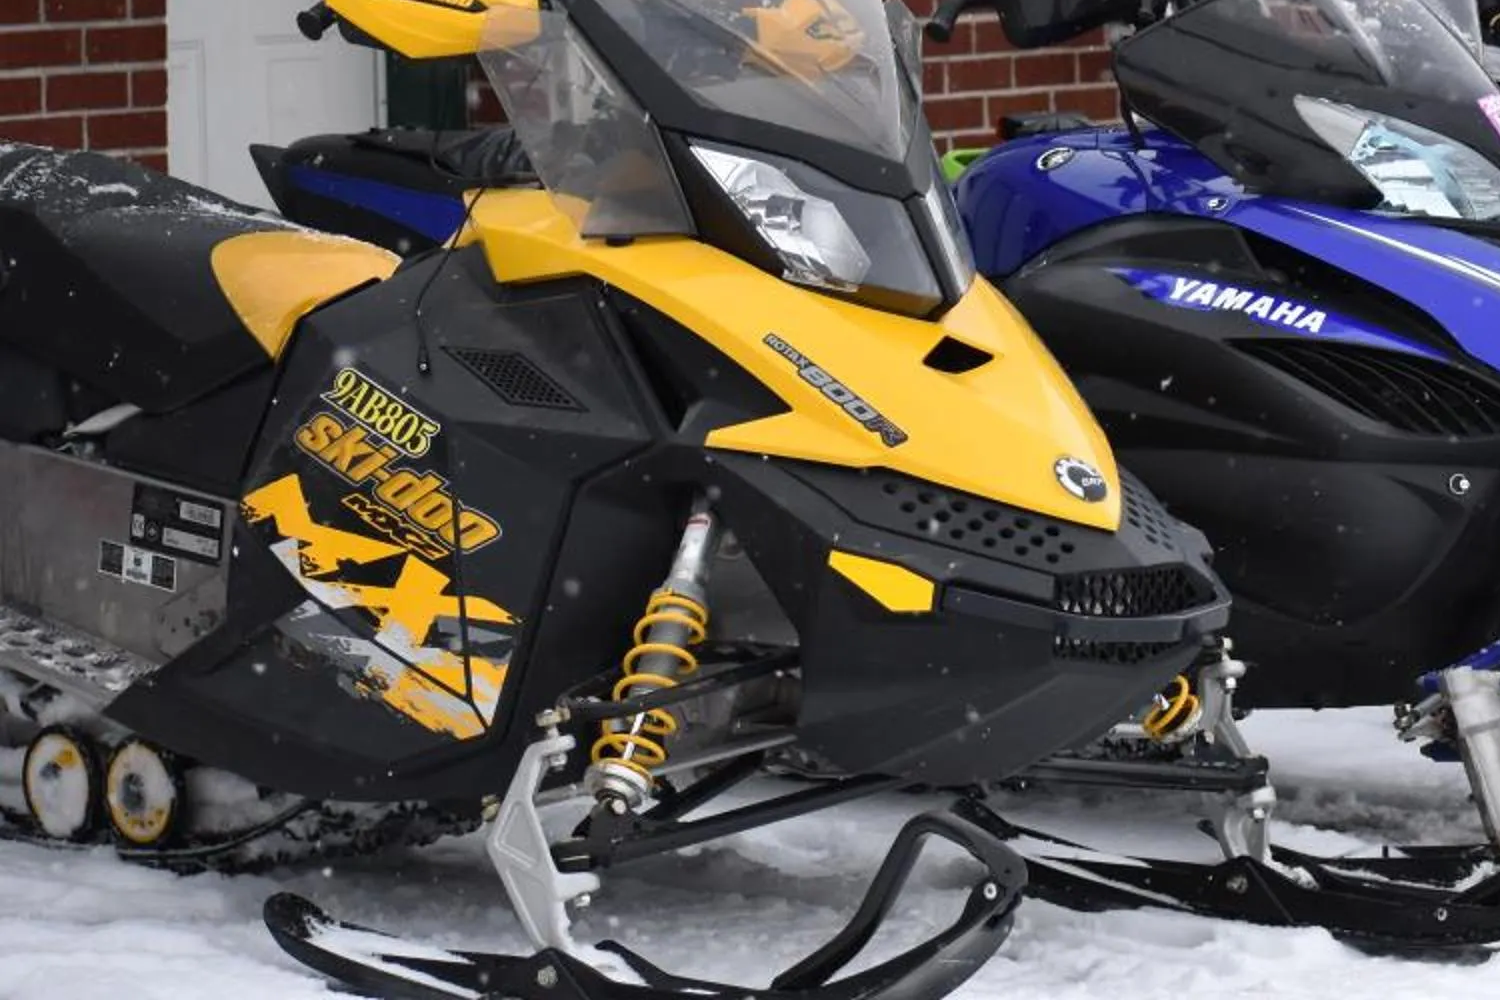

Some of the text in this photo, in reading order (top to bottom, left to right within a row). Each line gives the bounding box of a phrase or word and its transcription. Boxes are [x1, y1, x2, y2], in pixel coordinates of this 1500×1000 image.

[1169, 277, 1327, 333] YAMAHA
[327, 369, 440, 455] 9AB805
[296, 413, 501, 553] ski-doo
